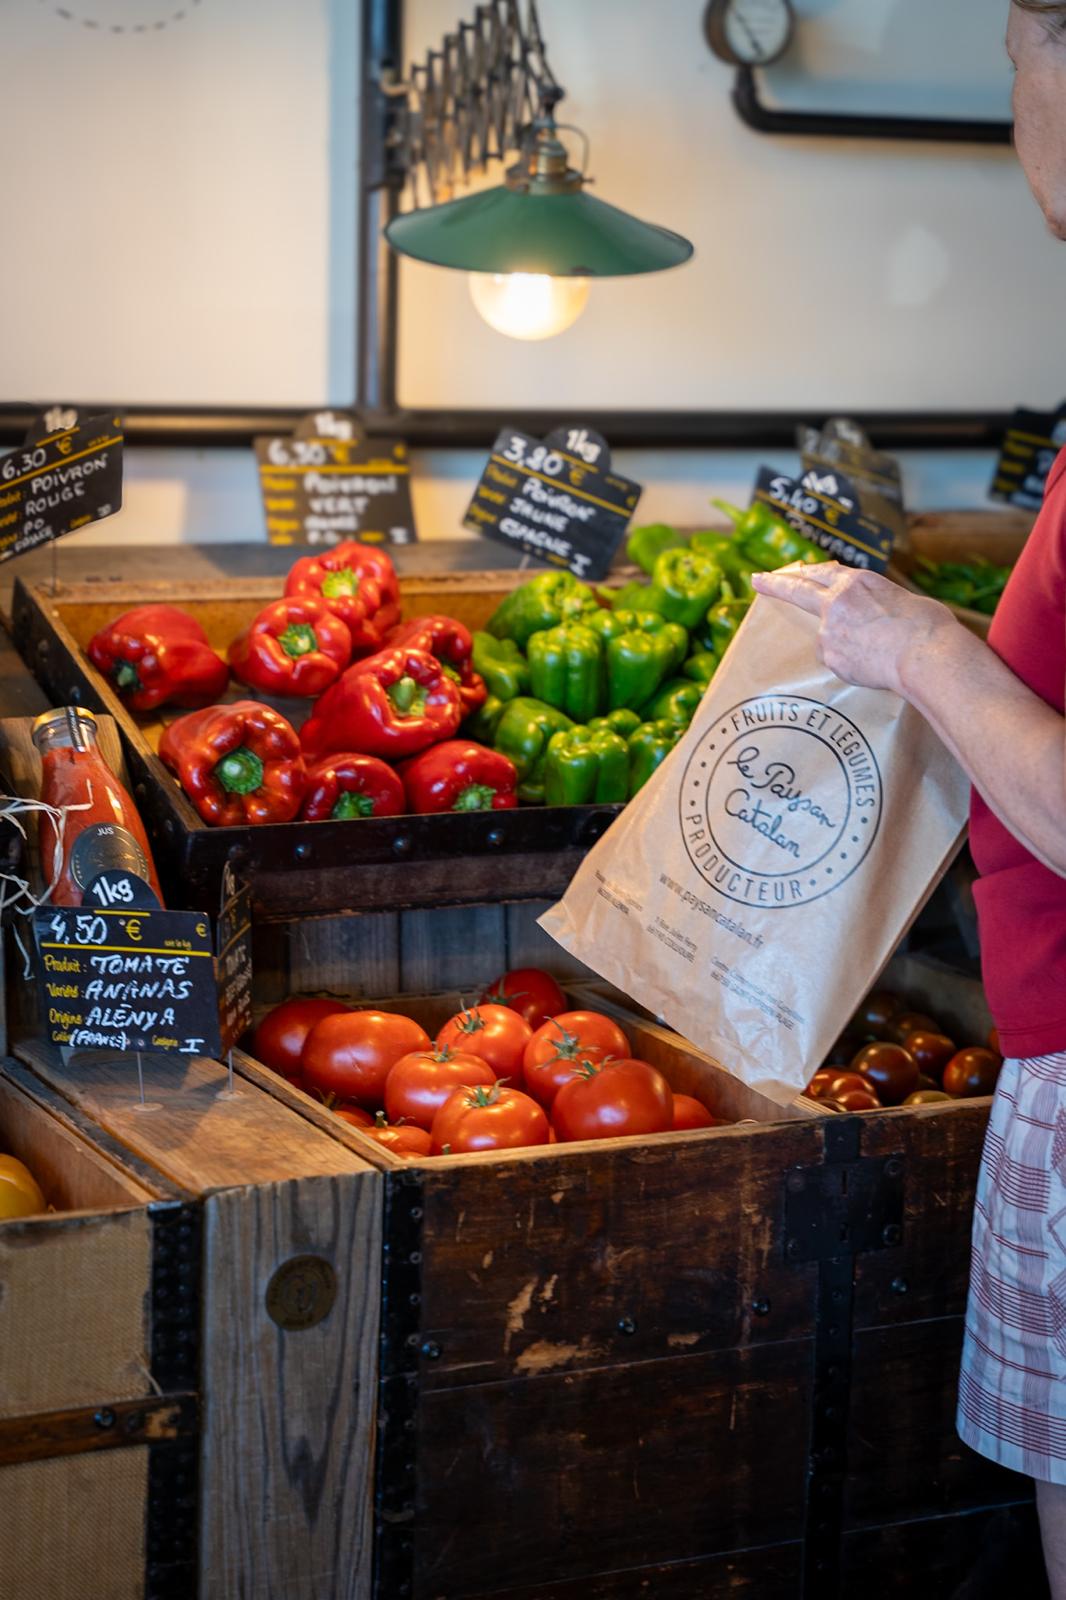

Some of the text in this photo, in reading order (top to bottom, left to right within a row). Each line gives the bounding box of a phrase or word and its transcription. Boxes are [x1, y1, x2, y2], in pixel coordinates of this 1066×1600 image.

[566, 429, 601, 463] 1kg
[31, 453, 108, 494] POIVRON
[25, 481, 85, 516] ROUGE
[509, 497, 569, 532] JAUNE
[731, 702, 876, 808] FRUITS ET LÉGUMES
[750, 762, 836, 829] Paysan
[97, 827, 115, 836] JUS
[725, 788, 800, 858] Catalan
[686, 813, 803, 903] PRODUCTEUR
[92, 876, 134, 906] 1kg
[659, 873, 764, 950] www.paysancatalan.fr
[50, 914, 143, 945] 4,50 €
[90, 954, 190, 975] TOMATE
[85, 978, 193, 1001] ANANAS
